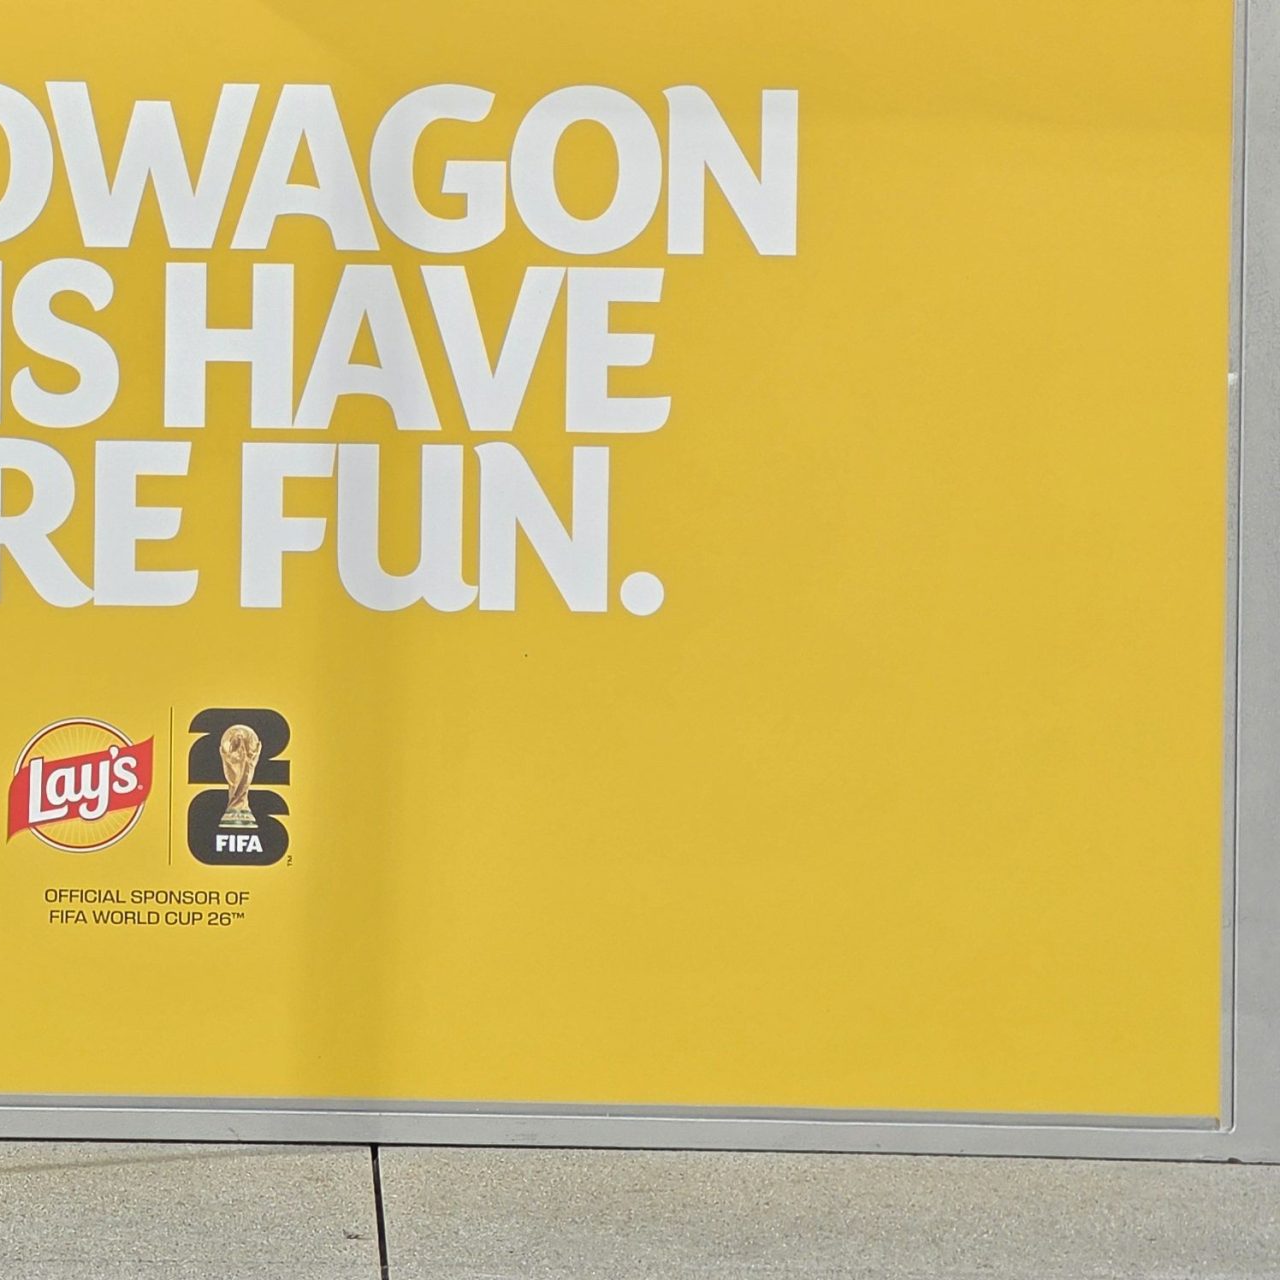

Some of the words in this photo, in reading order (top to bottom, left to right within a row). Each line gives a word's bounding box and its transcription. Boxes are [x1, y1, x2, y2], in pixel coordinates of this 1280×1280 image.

[164, 263, 672, 433] HAVE
[240, 442, 664, 616] FUN.
[28, 745, 139, 824] Lay's
[215, 834, 263, 853] FIFA
[44, 888, 126, 904] OFFICIAL
[130, 890, 220, 905] SPONSOR
[225, 891, 250, 905] OF
[49, 910, 88, 924] FIFA
[92, 910, 160, 925] WORLD
[165, 911, 203, 926] CUP
